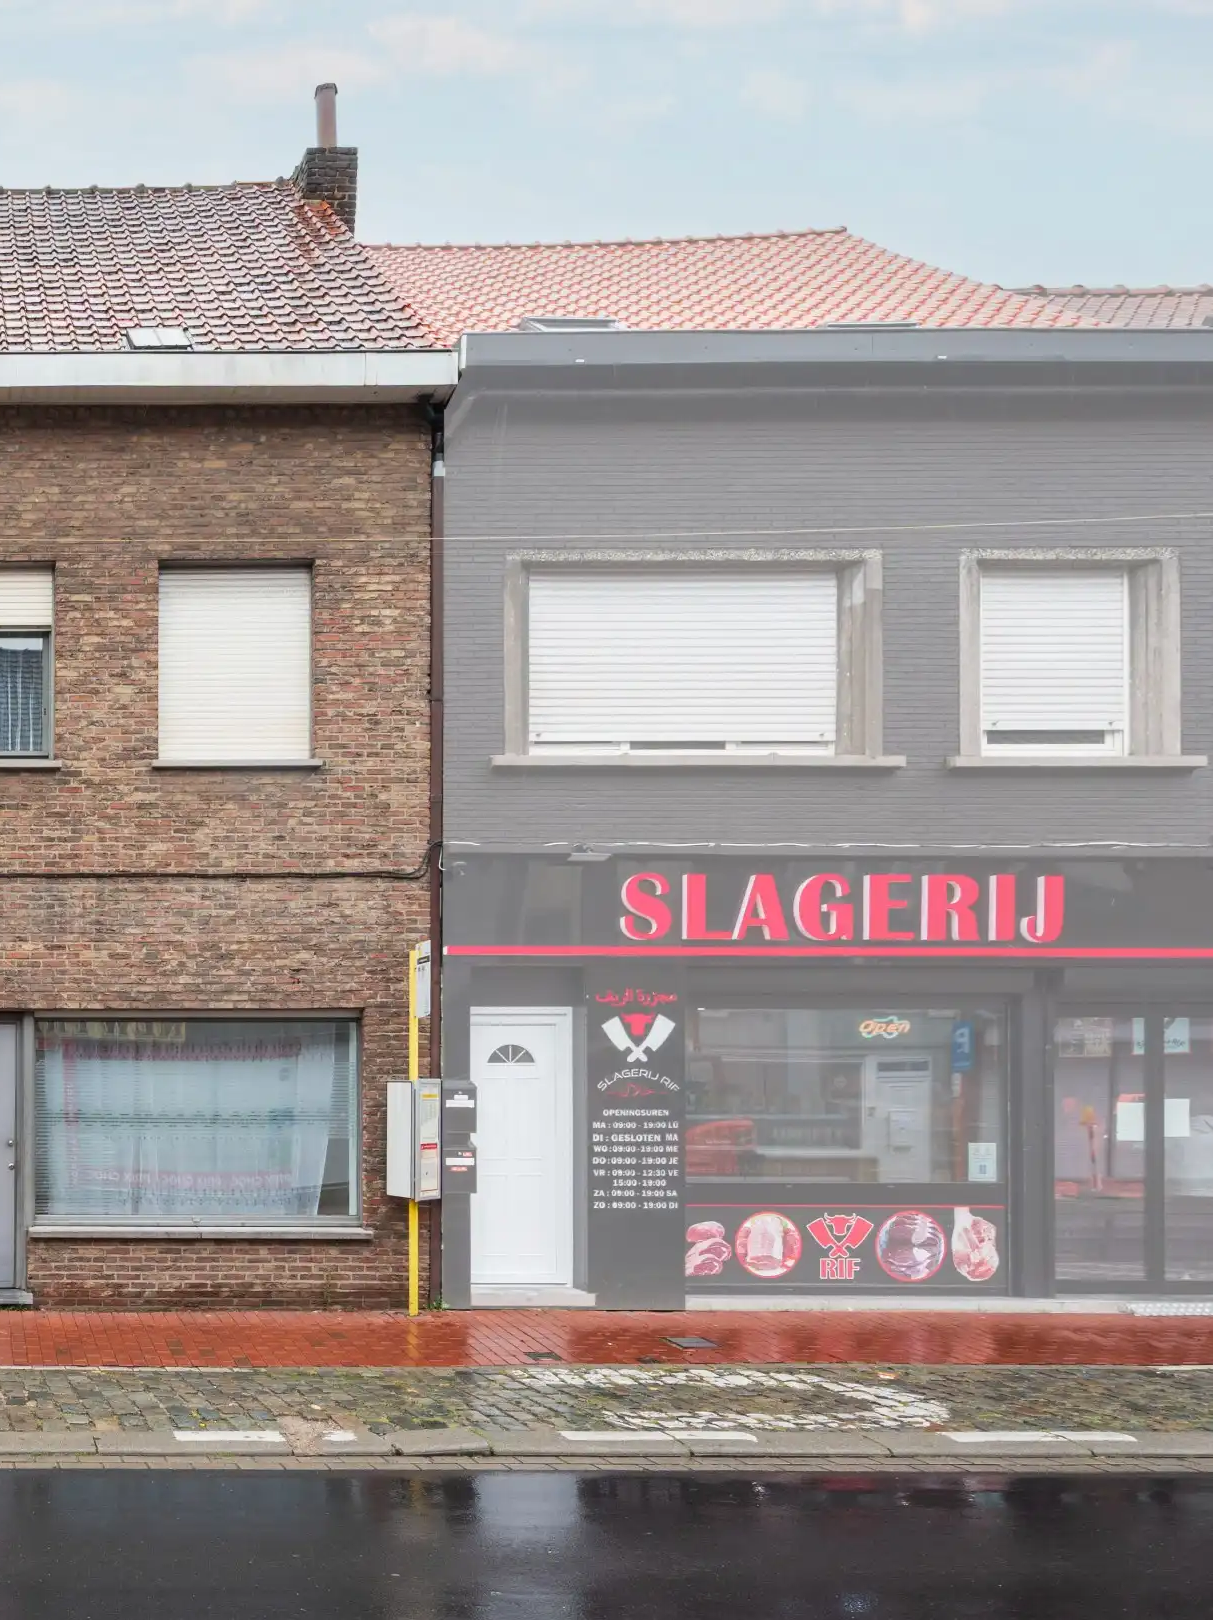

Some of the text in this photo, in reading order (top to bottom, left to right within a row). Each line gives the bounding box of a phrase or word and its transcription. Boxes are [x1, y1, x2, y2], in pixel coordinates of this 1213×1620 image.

[620, 873, 1065, 942] SLAGERIJ
[859, 1019, 911, 1035] Open
[596, 1068, 681, 1092] SLAGERIJ RIF
[602, 1109, 669, 1117] OPENINGSUREN
[592, 1121, 606, 1129] MA
[612, 1121, 637, 1129] 09:00
[643, 1121, 666, 1129] 19:00
[592, 1133, 604, 1142] DI
[611, 1133, 662, 1142] GESLOTEN
[665, 1133, 679, 1142] MA
[593, 1145, 608, 1153] WO
[666, 1145, 679, 1153] ME
[592, 1156, 607, 1165] DO
[668, 1156, 679, 1165] JE
[592, 1169, 606, 1177] VR
[612, 1169, 636, 1177] 09:00
[642, 1169, 666, 1177] 12:30
[667, 1169, 680, 1177] VE
[592, 1189, 606, 1197] ZA
[611, 1189, 635, 1197] 09:00
[641, 1189, 665, 1197] 19:00
[666, 1189, 678, 1197] SA
[593, 1201, 606, 1209] ZO
[612, 1201, 636, 1209] 09:00
[643, 1201, 667, 1209] 19:00
[668, 1201, 678, 1209] DI
[819, 1257, 861, 1280] RIF
